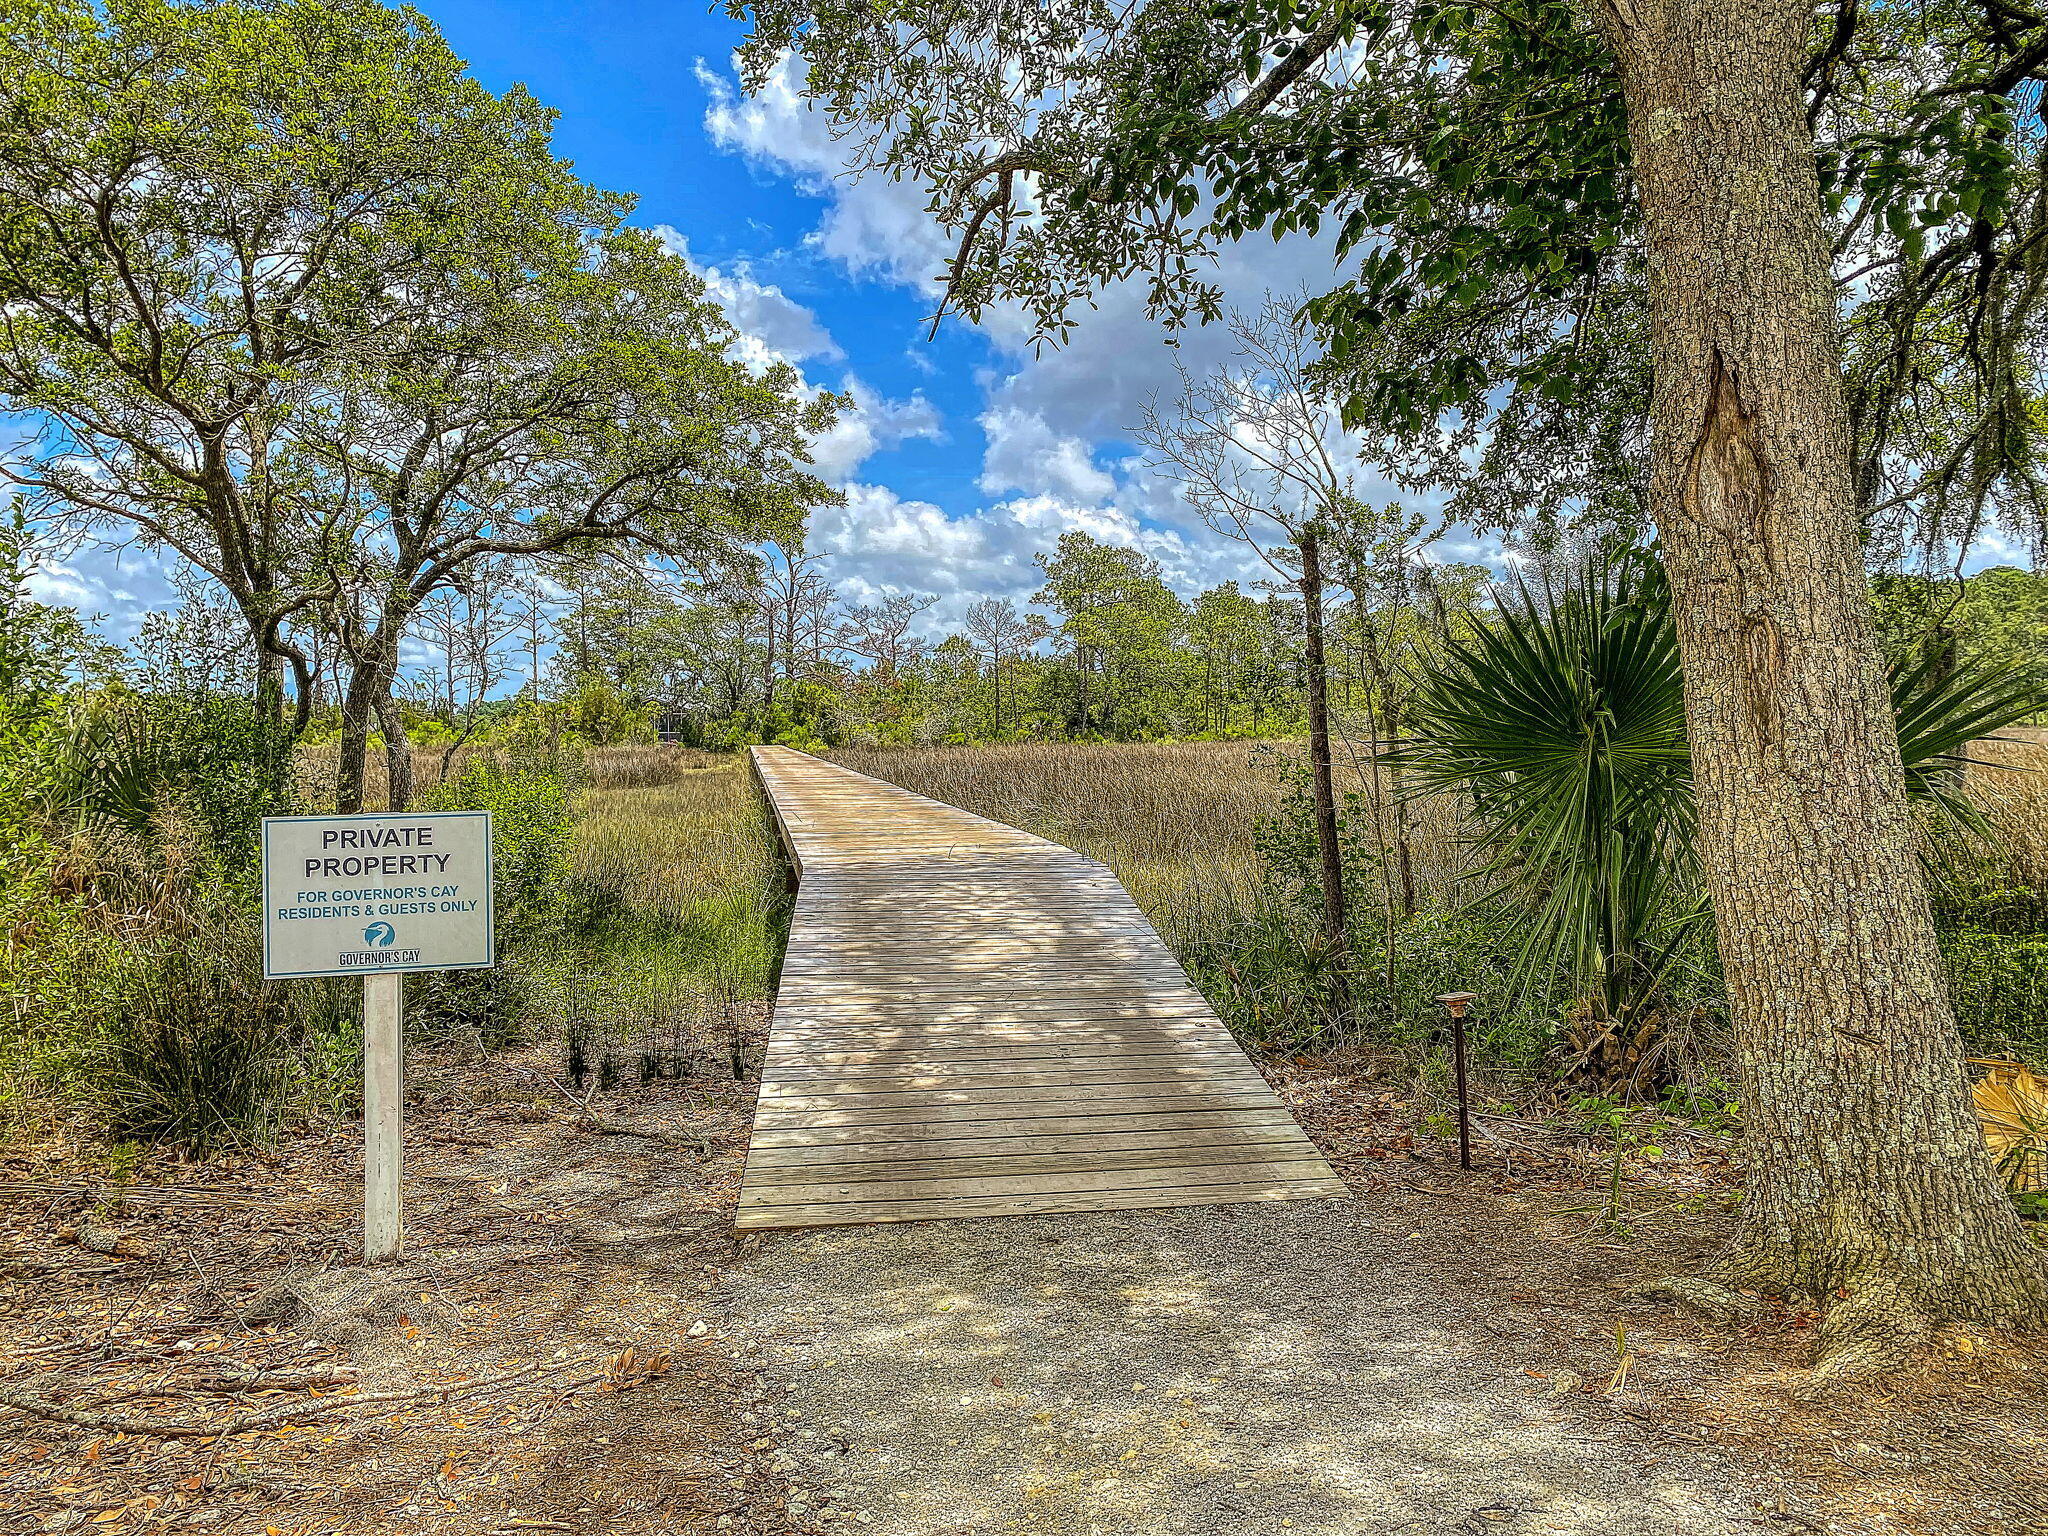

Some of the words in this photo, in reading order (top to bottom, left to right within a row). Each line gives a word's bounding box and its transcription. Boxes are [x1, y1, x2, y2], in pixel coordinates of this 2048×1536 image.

[322, 827, 433, 850] PRIVATE
[305, 853, 451, 878] PROPERTY
[297, 891, 328, 904] FOR
[331, 887, 427, 902] GOVERNOR'S
[431, 885, 459, 897] CAY
[278, 904, 360, 920] RESIDENTS
[364, 904, 375, 916] &
[378, 901, 436, 915] GUESTS
[440, 900, 478, 913] ONLY
[339, 951, 400, 966] GOVERNOR'S
[402, 949, 420, 963] CAY
